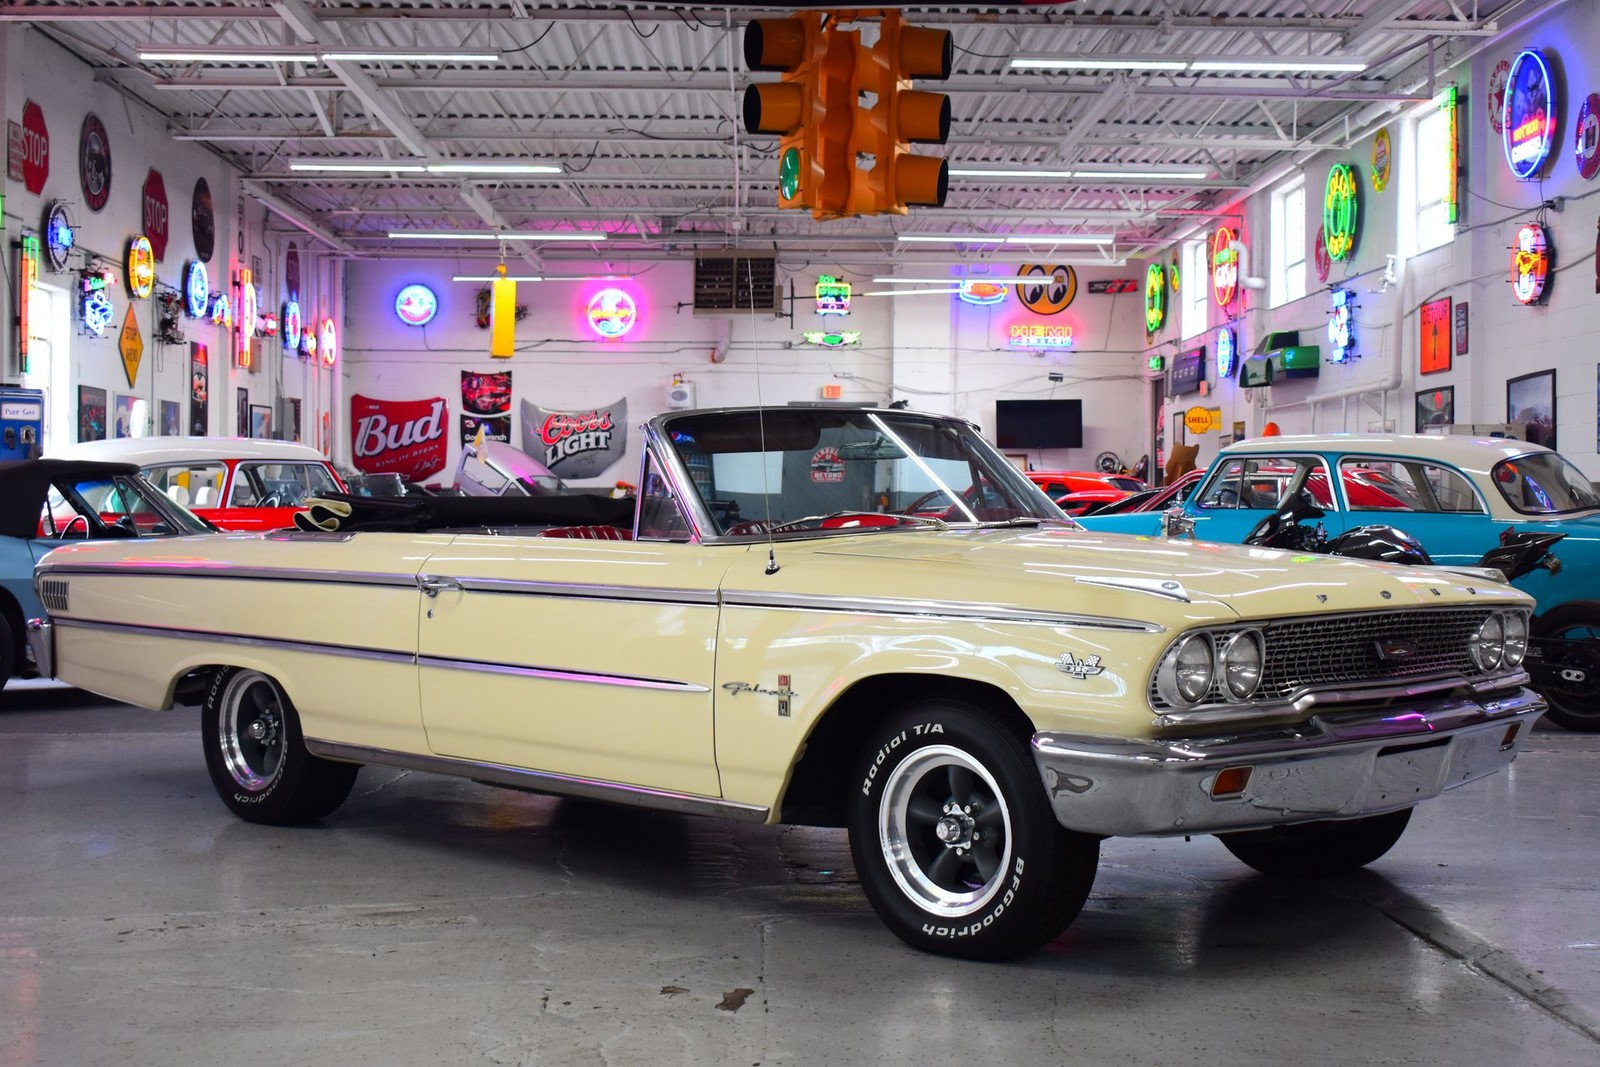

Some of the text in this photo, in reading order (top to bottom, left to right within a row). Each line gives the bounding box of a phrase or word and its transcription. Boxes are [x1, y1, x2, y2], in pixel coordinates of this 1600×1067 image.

[22, 127, 48, 168] STOP
[146, 196, 167, 234] STOP
[1011, 325, 1073, 338] HEMI
[355, 401, 442, 457] Bud
[465, 420, 475, 428] 3
[536, 409, 613, 446] Coors
[1187, 416, 1209, 424] SHELL
[545, 431, 610, 468] LIGHT
[862, 722, 944, 796] Radial T/A
[922, 856, 1025, 939] BFGoodrich
